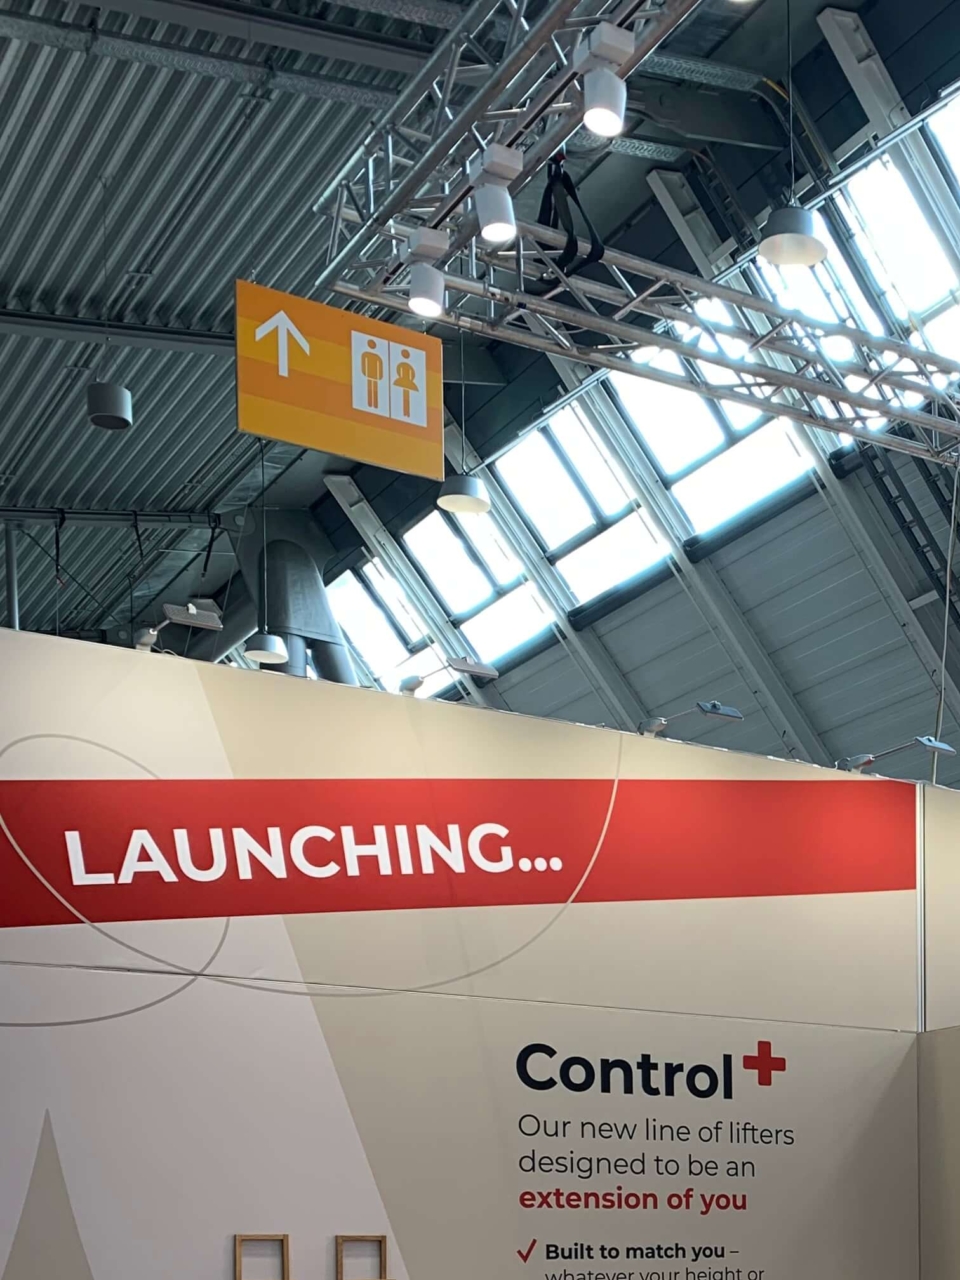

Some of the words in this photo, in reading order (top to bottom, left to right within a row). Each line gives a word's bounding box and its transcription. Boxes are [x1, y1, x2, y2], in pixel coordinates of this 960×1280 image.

[64, 822, 563, 886] LAUNCHING...
[518, 1114, 571, 1138] Our
[580, 1120, 637, 1140] new
[645, 1118, 691, 1142] line
[698, 1121, 723, 1144] of
[729, 1121, 795, 1145] lifters
[518, 1149, 646, 1179] designed
[654, 1155, 680, 1177] to
[688, 1154, 719, 1177] be
[726, 1158, 755, 1177] an
[519, 1185, 658, 1210] extension
[666, 1188, 694, 1210] of
[700, 1193, 747, 1216] you
[545, 1242, 594, 1260] Built
[599, 1245, 620, 1259] to
[625, 1243, 686, 1259] match
